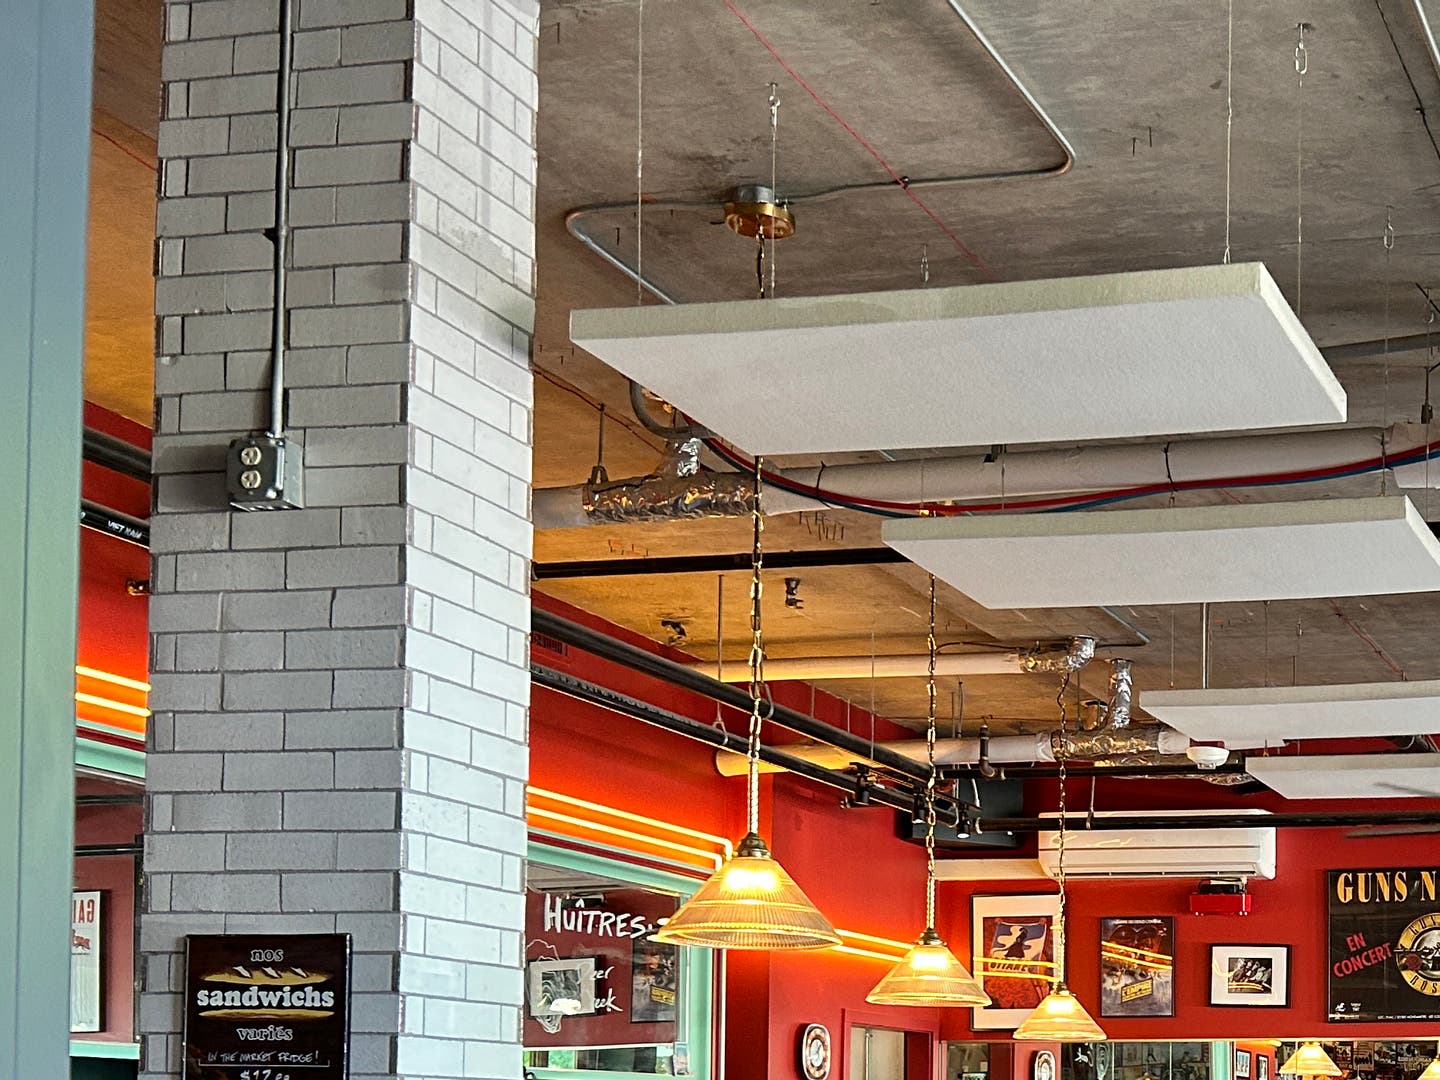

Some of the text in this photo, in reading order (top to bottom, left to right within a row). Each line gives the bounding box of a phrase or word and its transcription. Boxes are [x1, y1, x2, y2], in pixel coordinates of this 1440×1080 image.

[1337, 871, 1408, 903] GUNS
[1346, 932, 1367, 951] EN
[250, 949, 284, 962] nos
[1333, 942, 1393, 978] CONCERT
[197, 986, 335, 1008] sandwichs
[236, 1025, 294, 1041] variés
